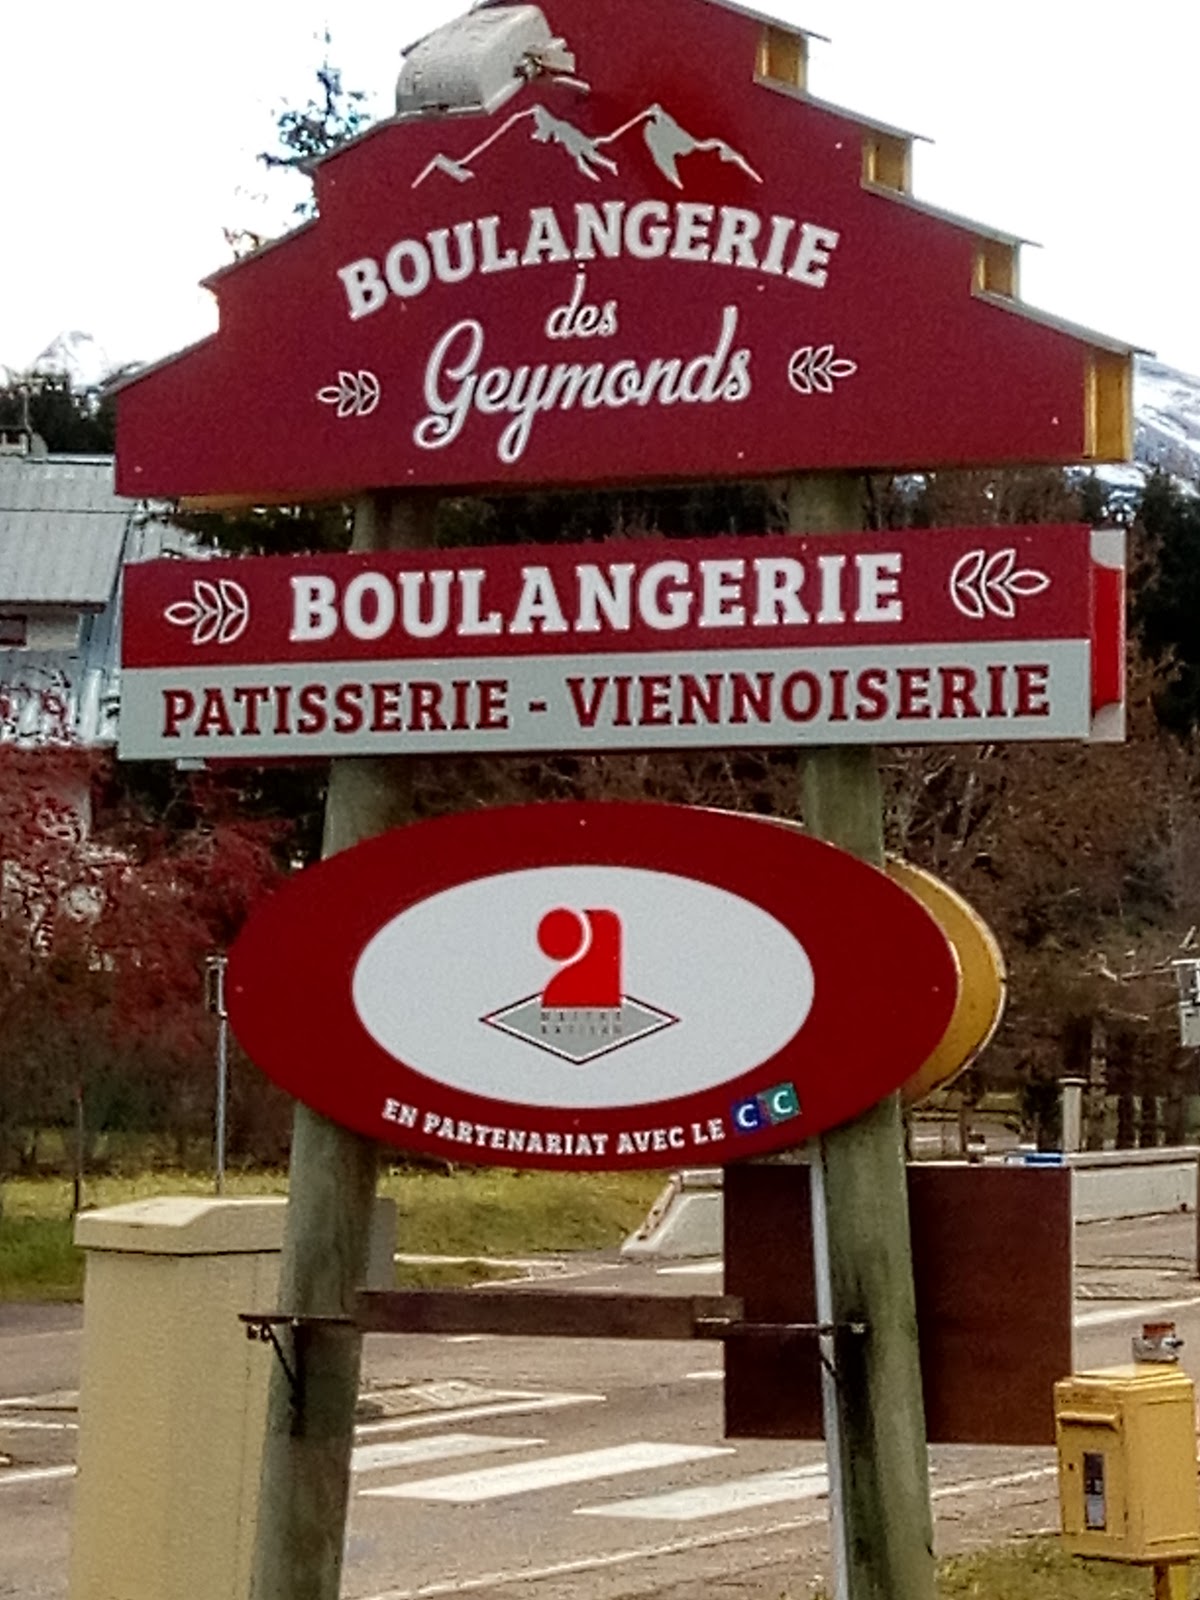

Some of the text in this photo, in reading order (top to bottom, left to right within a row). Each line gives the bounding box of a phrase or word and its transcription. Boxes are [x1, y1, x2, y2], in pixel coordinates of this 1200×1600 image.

[337, 200, 840, 322] BOULANGERIE
[545, 272, 618, 339] des
[413, 305, 751, 463] Geymonds
[289, 552, 903, 642] BOULANGERIE
[162, 678, 509, 738] PATISSERIE
[565, 664, 1050, 728] VIENNOISERIE
[382, 1098, 418, 1129] EN
[423, 1112, 609, 1156] PARTENARIAT
[617, 1126, 686, 1155] AVEC
[691, 1118, 726, 1146] LE
